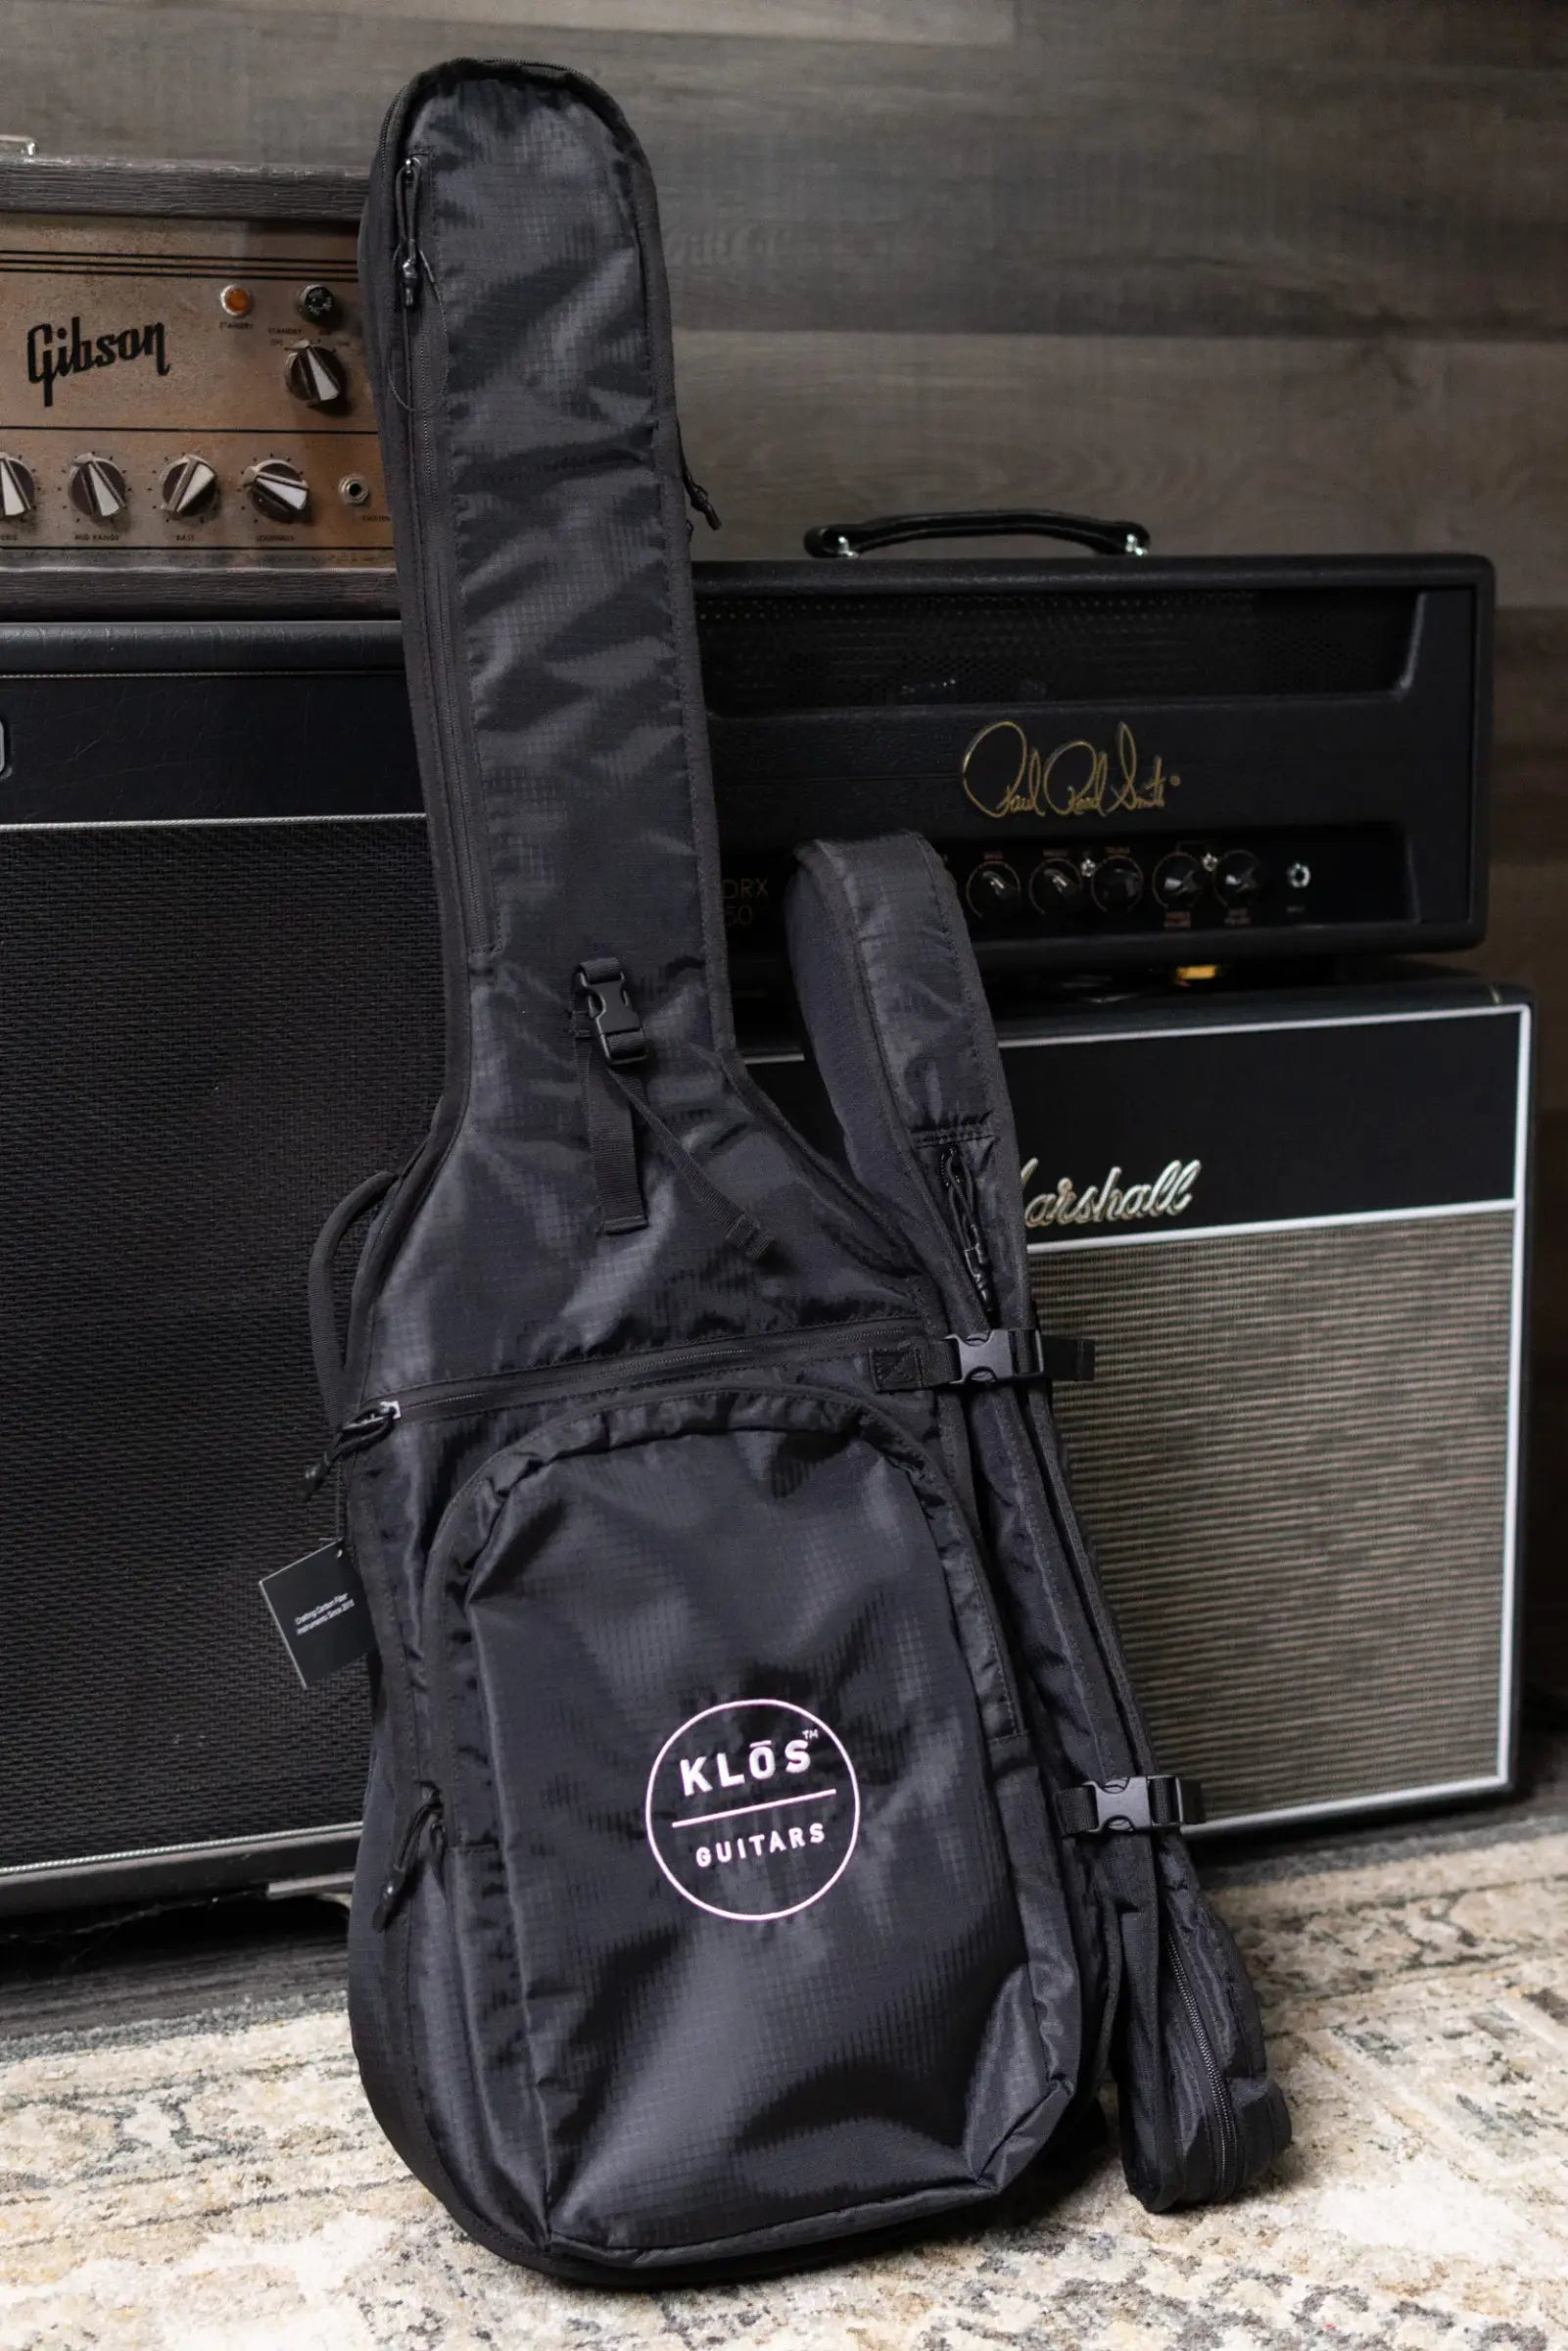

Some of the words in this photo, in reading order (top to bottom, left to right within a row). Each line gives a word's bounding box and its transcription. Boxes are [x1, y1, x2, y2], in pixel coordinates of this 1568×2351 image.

[27, 316, 170, 408] Gibson
[963, 721, 1045, 818] Paul
[1043, 741, 1108, 817] Reed
[1103, 720, 1166, 817] Smith
[1021, 1158, 1201, 1227] arshall
[695, 1822, 826, 1867] GUITARS
